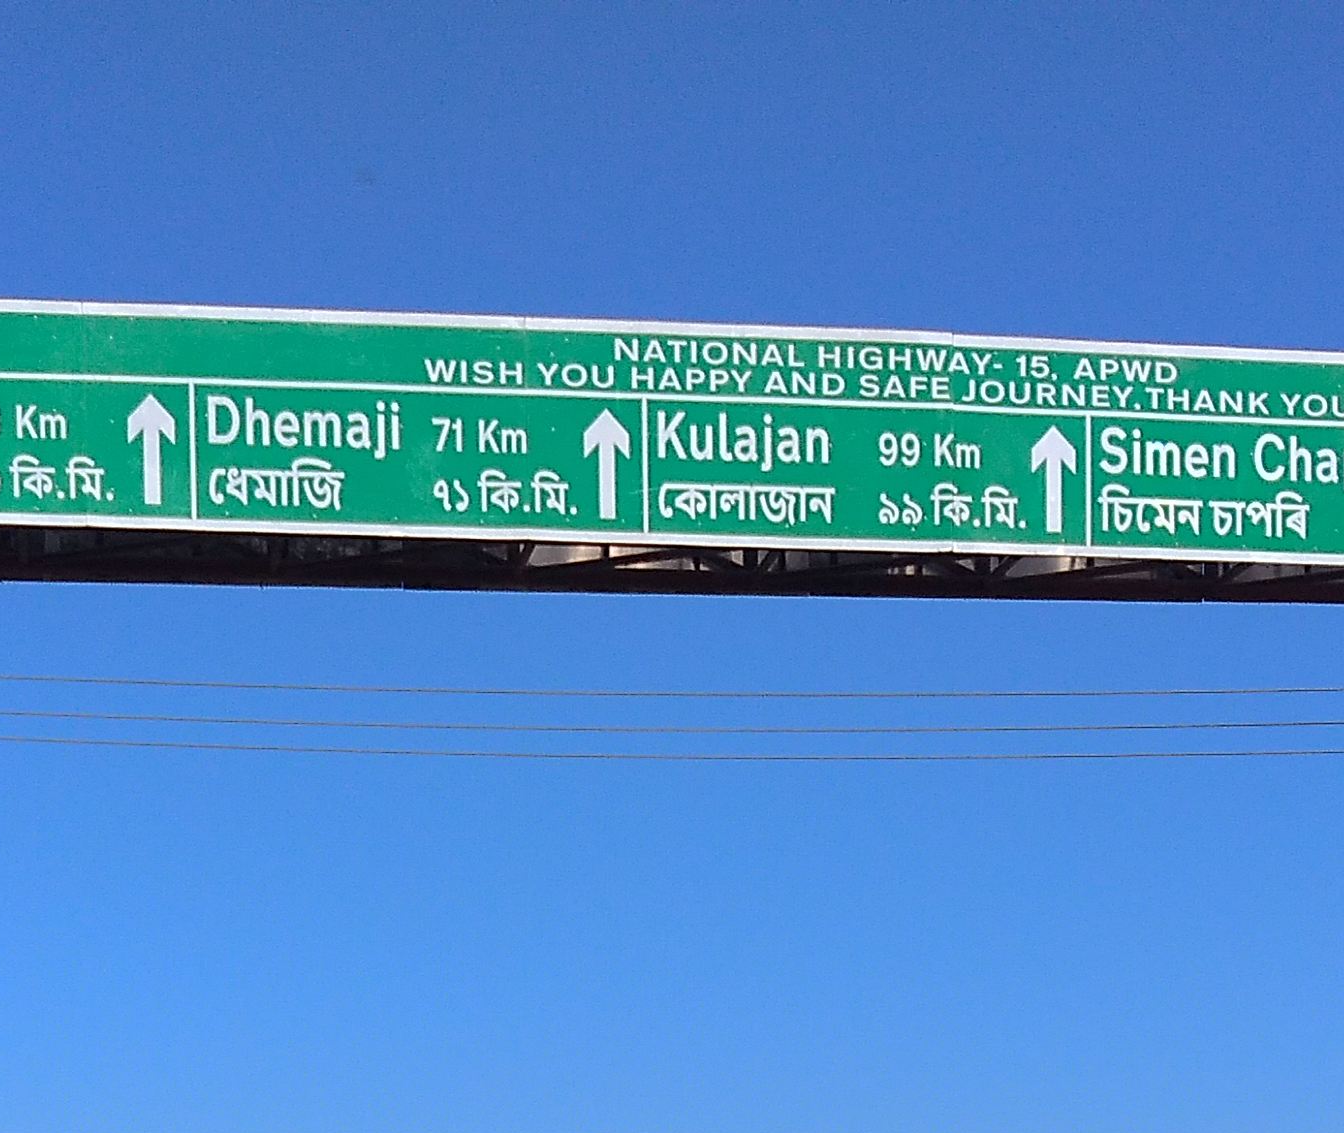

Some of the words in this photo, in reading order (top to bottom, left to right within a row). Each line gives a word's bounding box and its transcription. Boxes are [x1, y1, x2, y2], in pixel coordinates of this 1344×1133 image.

[424, 358, 523, 385] WISH
[537, 362, 615, 388] YOU
[630, 366, 753, 394] HAPPY
[764, 371, 845, 397] AND
[860, 375, 950, 399] SAFE
[613, 337, 805, 368] NATIONAL
[1017, 355, 1057, 380] 15,
[1073, 357, 1179, 384] APWD
[16, 405, 66, 438] Km
[207, 395, 400, 460] Dhemaji
[432, 418, 462, 451] 71
[479, 420, 526, 453] Km
[658, 411, 828, 471] Kulajan
[880, 433, 919, 466] 99
[935, 434, 980, 468] Km
[1100, 427, 1235, 477] Simen
[9, 455, 113, 500] কি.মি.
[210, 458, 344, 510] ধেমাজি
[434, 480, 468, 511] ৭১
[478, 470, 577, 514] কি.মি.
[659, 483, 835, 525] কোলাজান
[879, 494, 922, 524] ৯৯
[931, 483, 1025, 528] কি.মি.
[1098, 484, 1203, 534] চিমেন
